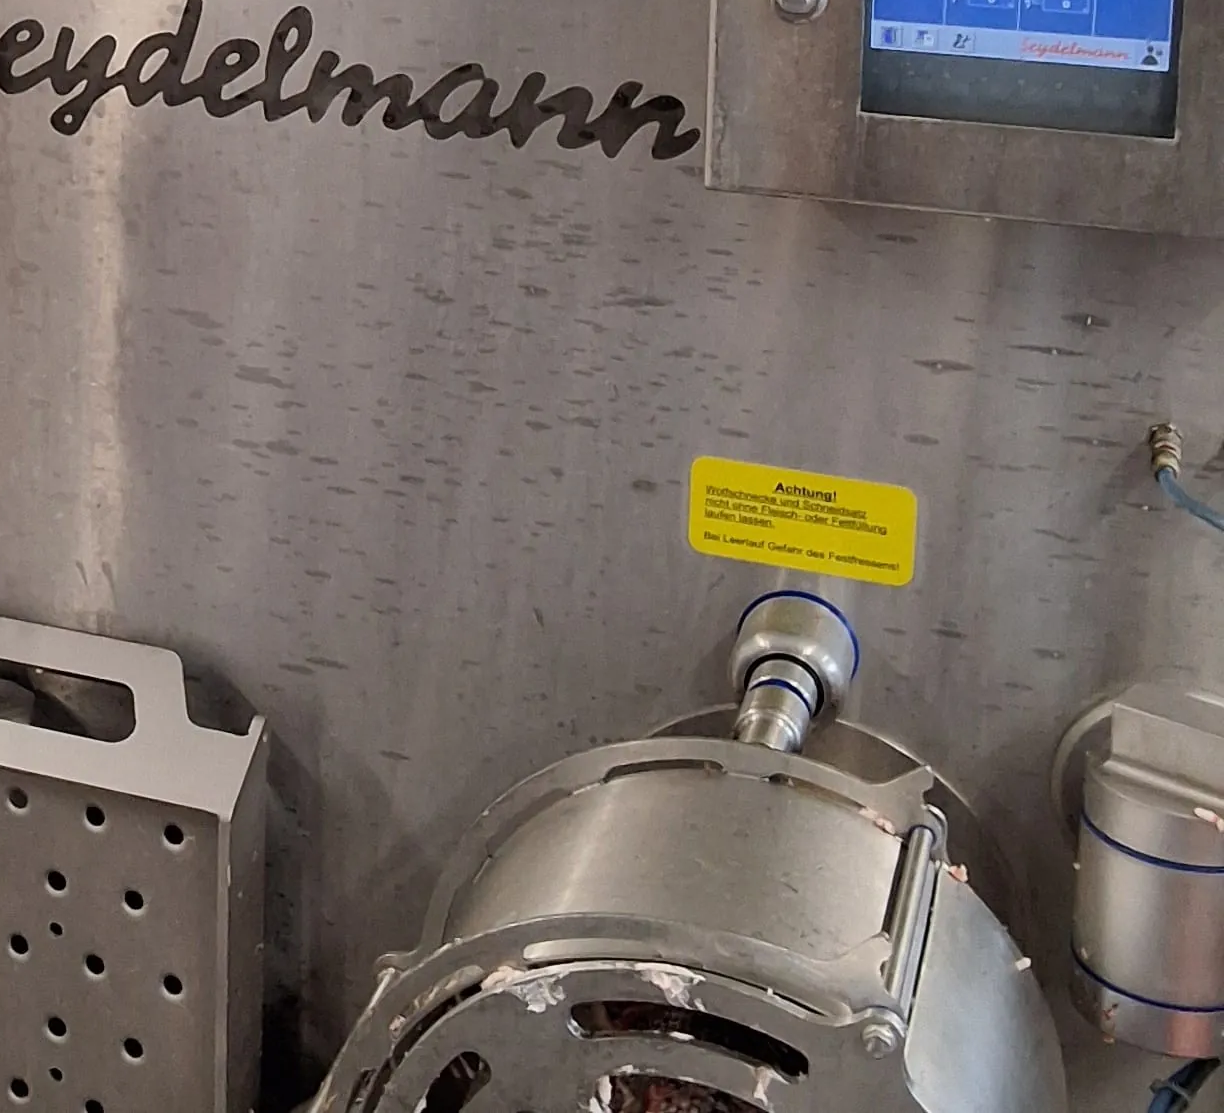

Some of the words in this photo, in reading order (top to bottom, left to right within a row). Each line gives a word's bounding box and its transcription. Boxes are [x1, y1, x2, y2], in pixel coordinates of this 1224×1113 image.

[775, 482, 837, 503] Achtung!
[704, 498, 730, 510] nicht
[732, 502, 758, 514] ohne
[805, 513, 828, 525] oder
[704, 507, 736, 521] laufen
[779, 497, 800, 510] und
[703, 531, 721, 542] Bei
[723, 534, 765, 549] Leerlauf
[767, 541, 803, 555] Gefahr
[805, 549, 825, 560] des
